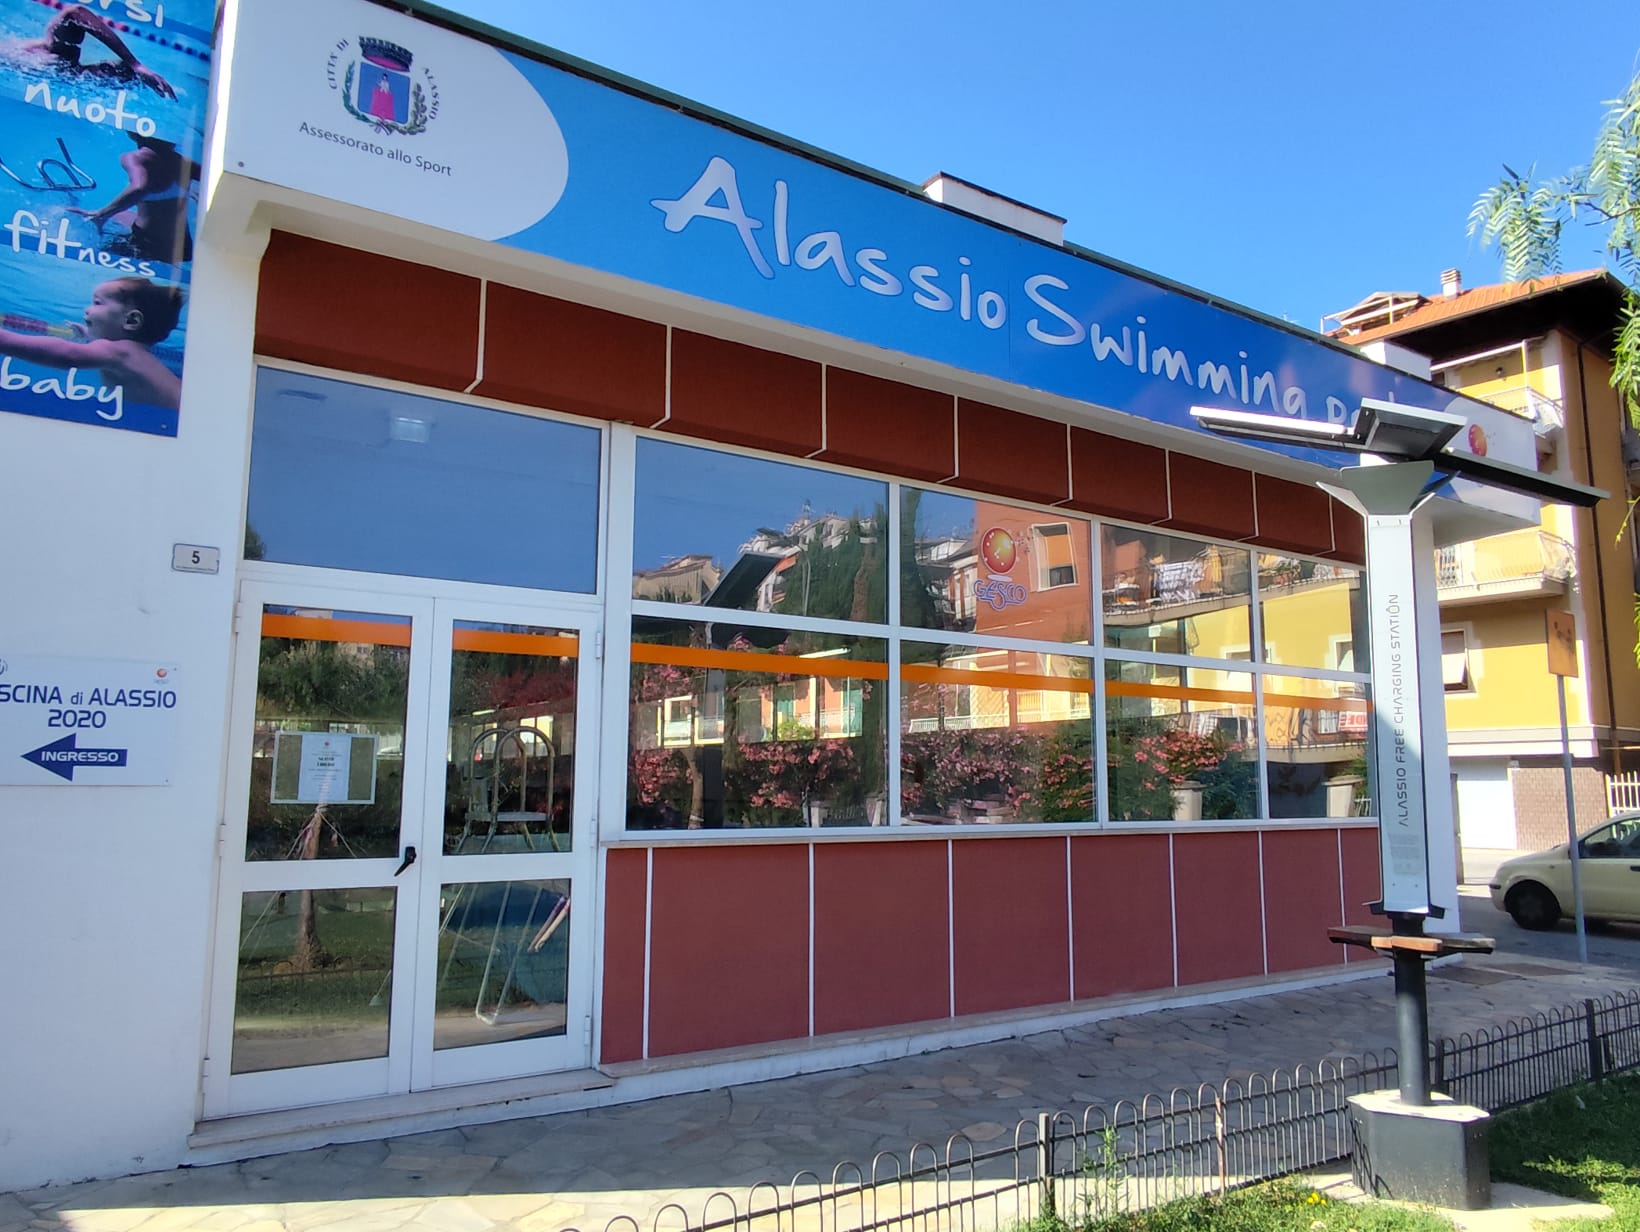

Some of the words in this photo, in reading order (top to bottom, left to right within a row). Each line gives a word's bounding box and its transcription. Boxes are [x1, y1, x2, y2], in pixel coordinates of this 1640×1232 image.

[24, 81, 156, 138] nuoto
[299, 121, 384, 156] Assessorato
[387, 149, 412, 164] allo
[415, 155, 452, 176] Sport
[4, 209, 157, 278] fitness
[650, 156, 1007, 329] Alassio
[0, 356, 123, 420] baby
[191, 550, 201, 564] 5
[71, 692, 83, 705] di
[88, 688, 176, 708] ALASSIO
[1392, 654, 1404, 724] CHARGING
[48, 709, 106, 728] 2020
[1393, 729, 1407, 763] FREE
[41, 751, 119, 762] INGRESSO
[1393, 767, 1408, 827] ALASSIO
